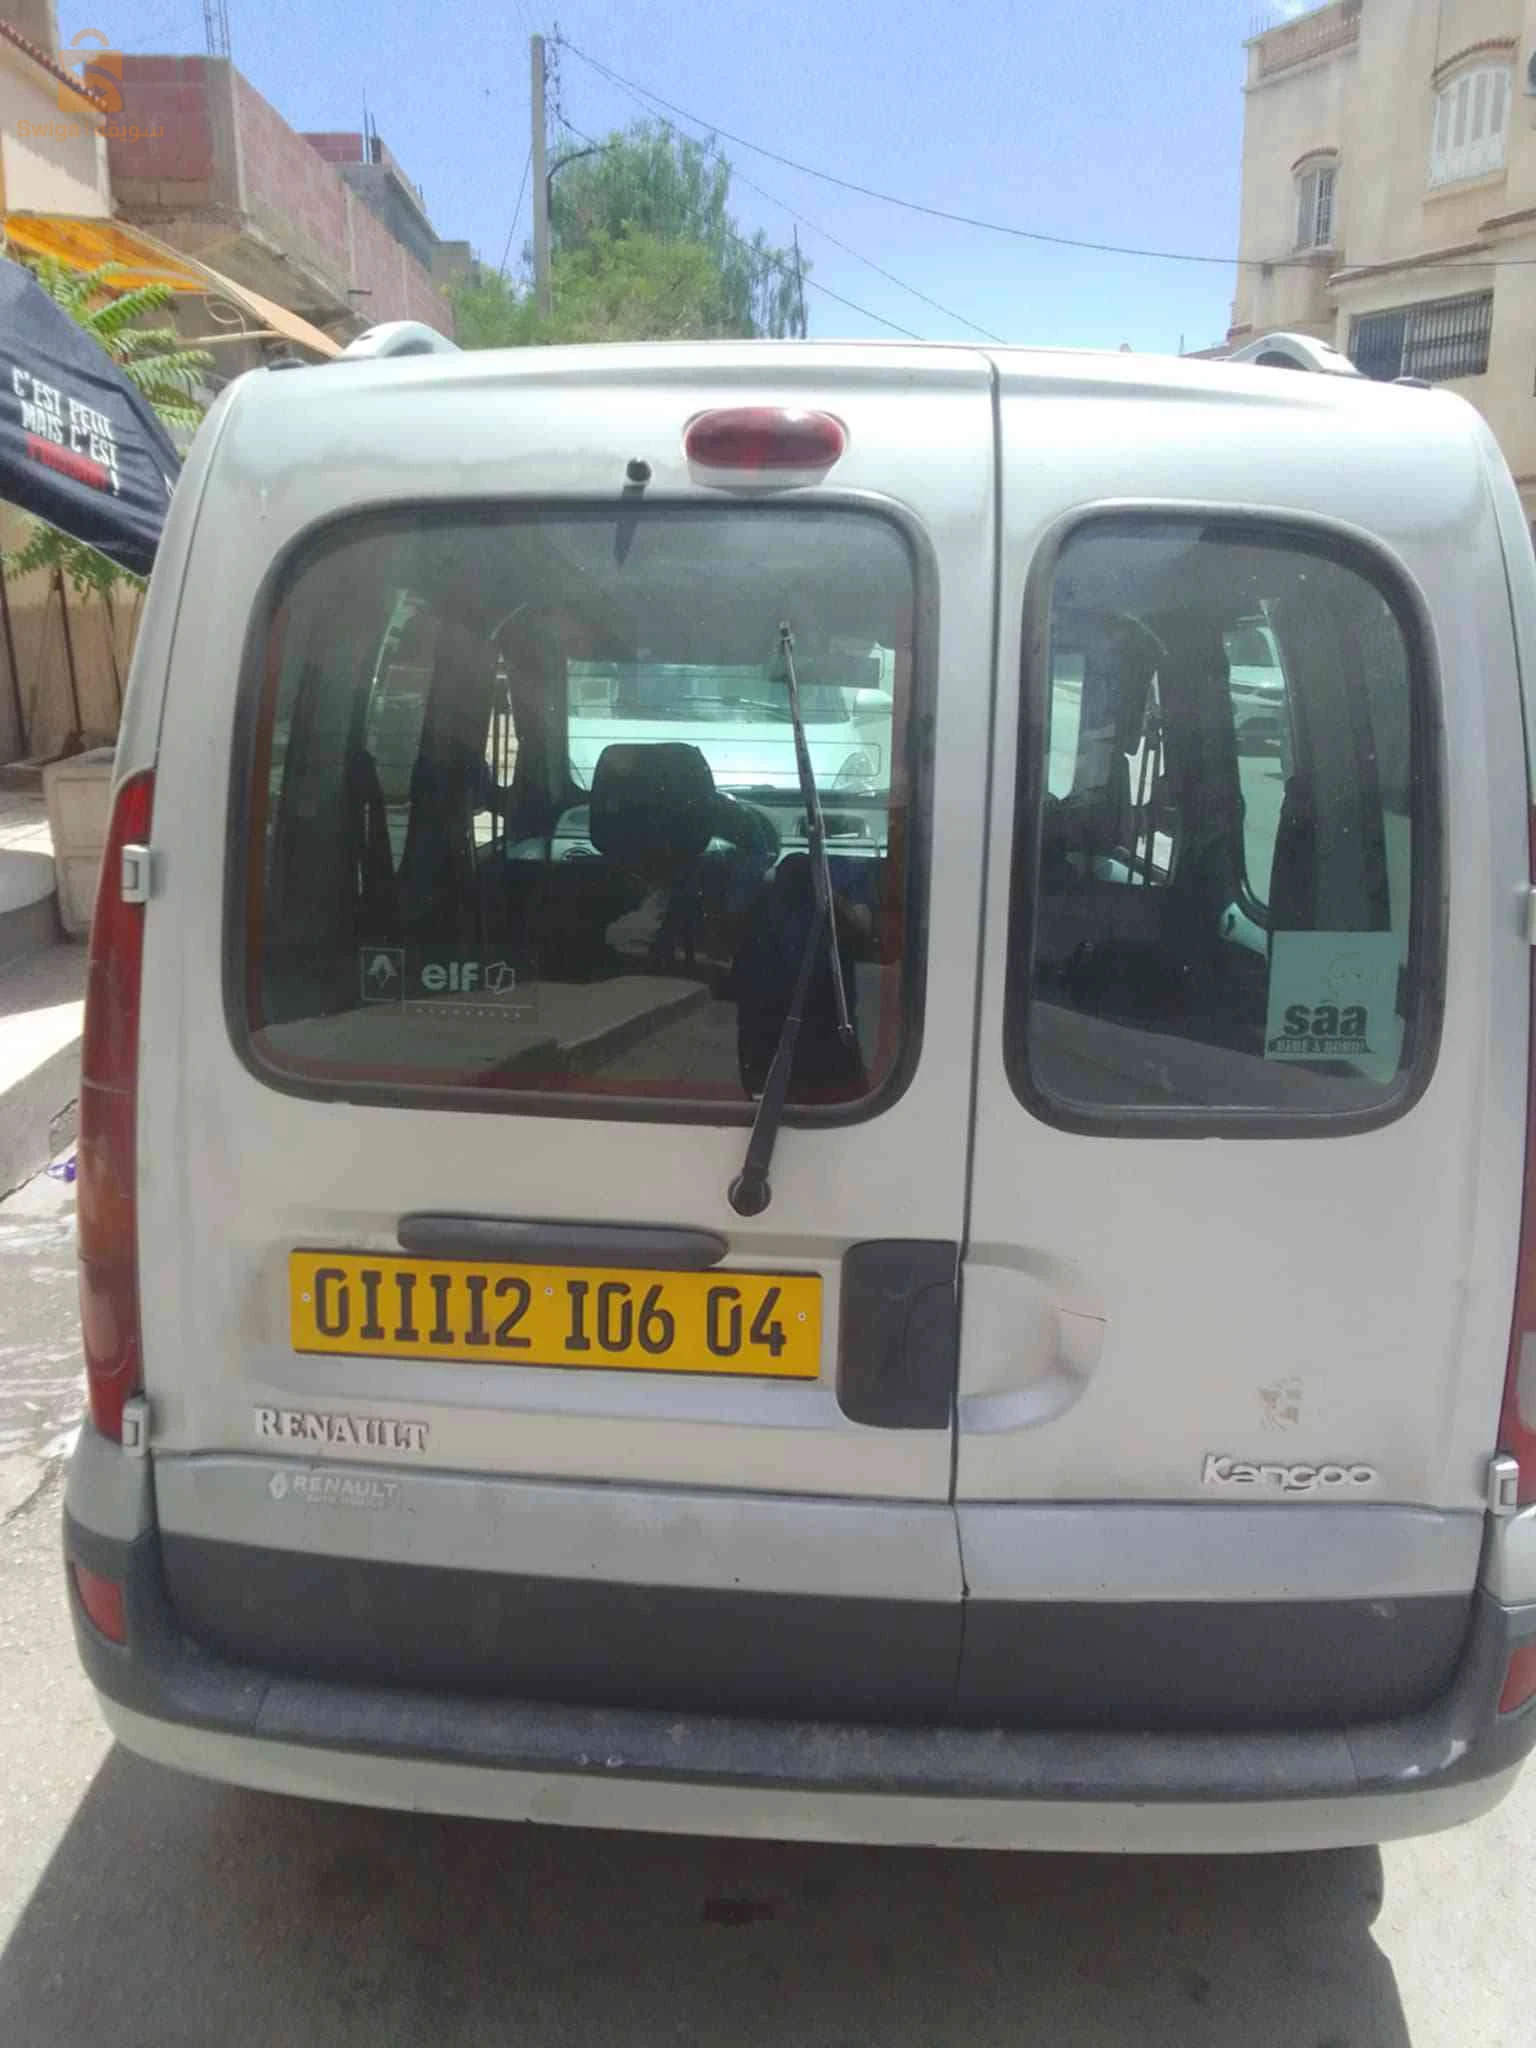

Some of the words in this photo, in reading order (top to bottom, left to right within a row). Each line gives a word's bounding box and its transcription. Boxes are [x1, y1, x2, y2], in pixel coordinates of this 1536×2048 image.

[421, 961, 480, 992] elf
[1283, 1005, 1368, 1036] saa
[315, 1267, 532, 1349] 011112
[565, 1280, 675, 1354] 106
[706, 1285, 787, 1357] 04
[253, 1405, 430, 1452] RENAULT
[292, 1474, 398, 1498] RENAULT
[1202, 1453, 1376, 1495] Kangoo
